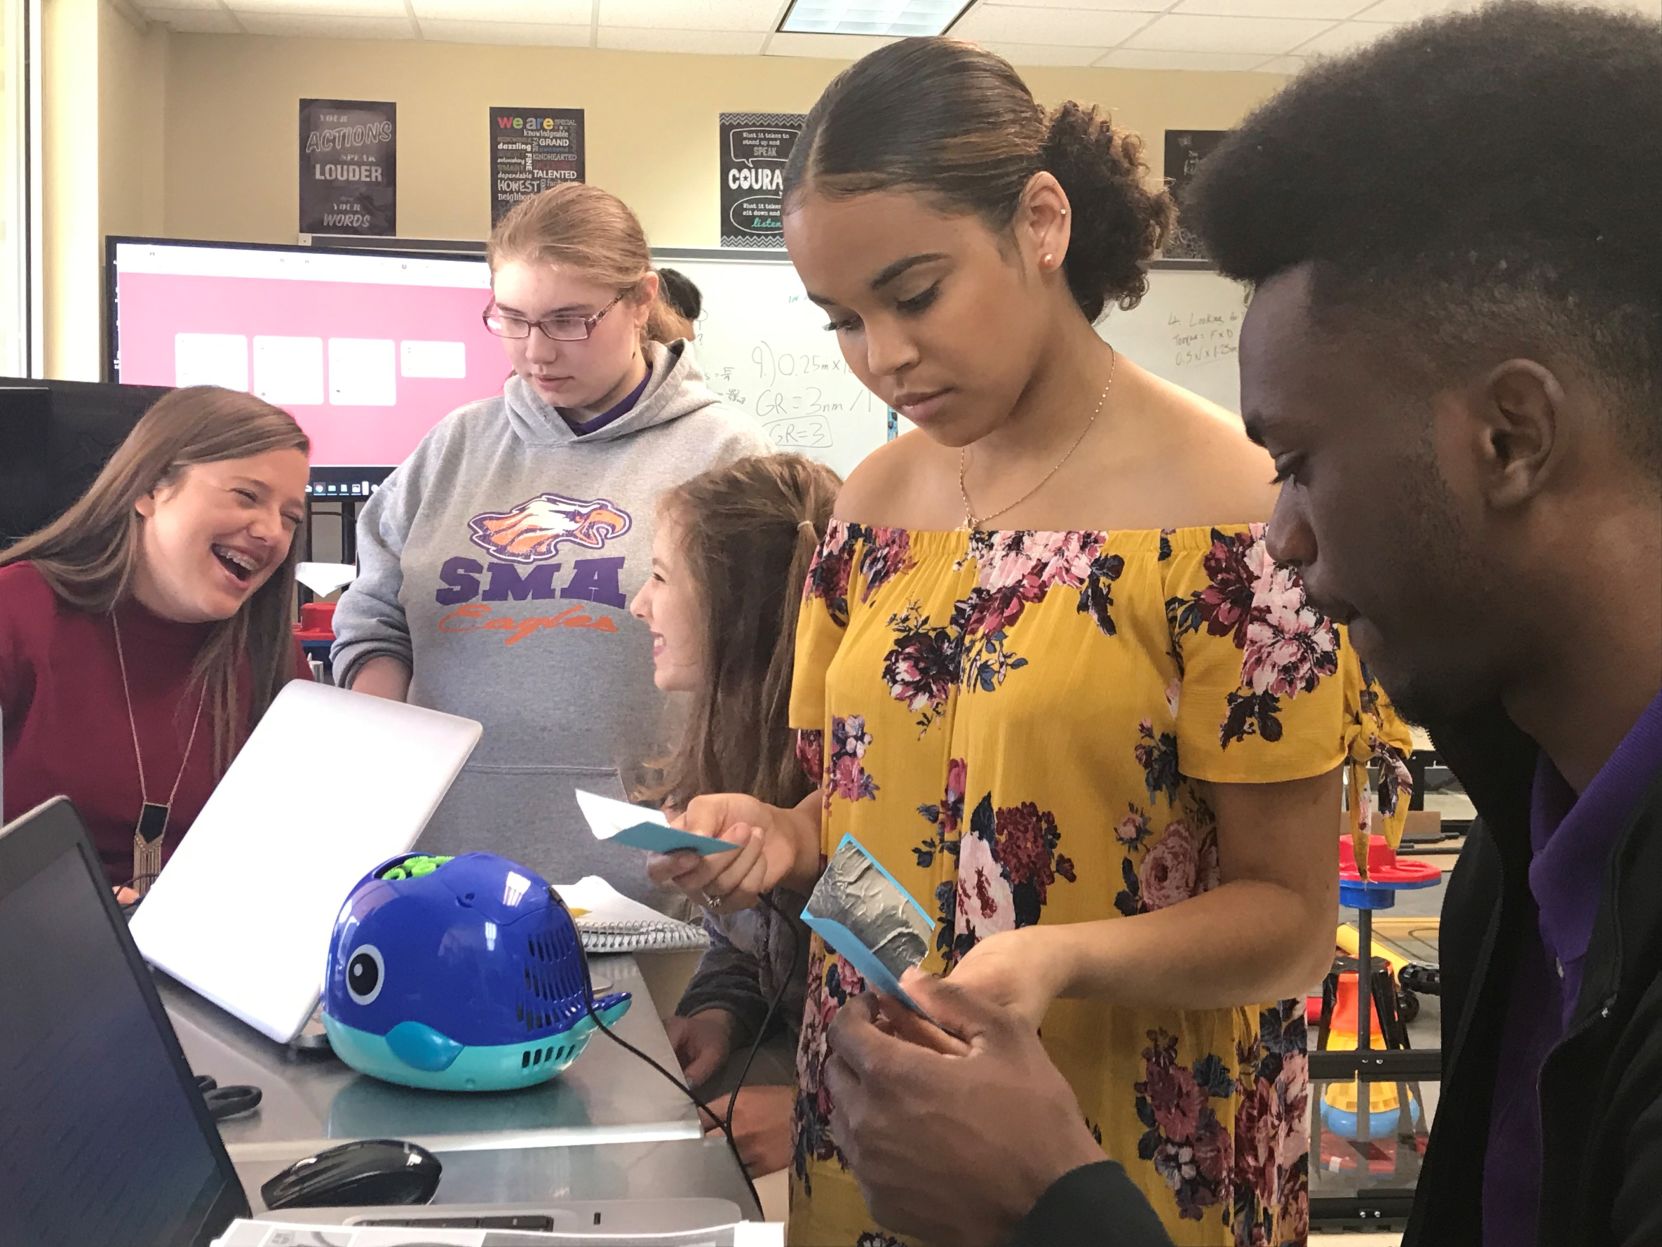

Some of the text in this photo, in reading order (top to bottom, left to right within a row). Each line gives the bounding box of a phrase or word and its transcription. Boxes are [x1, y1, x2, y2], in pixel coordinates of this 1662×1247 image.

[497, 116, 554, 129] we are
[306, 120, 392, 153] ACTIONS
[539, 138, 570, 147] GRAND
[497, 142, 532, 152] dazzling
[753, 147, 777, 156] SPEAK
[525, 153, 533, 171] FINE
[533, 153, 577, 161] KINDHEARTED
[315, 163, 383, 182] LOUDER
[533, 169, 577, 179] TALENTED
[728, 168, 784, 190] COURA
[497, 180, 540, 192] HONEST
[323, 214, 371, 228] WORDS
[435, 556, 627, 609] SMA
[437, 604, 618, 646] Eagles
